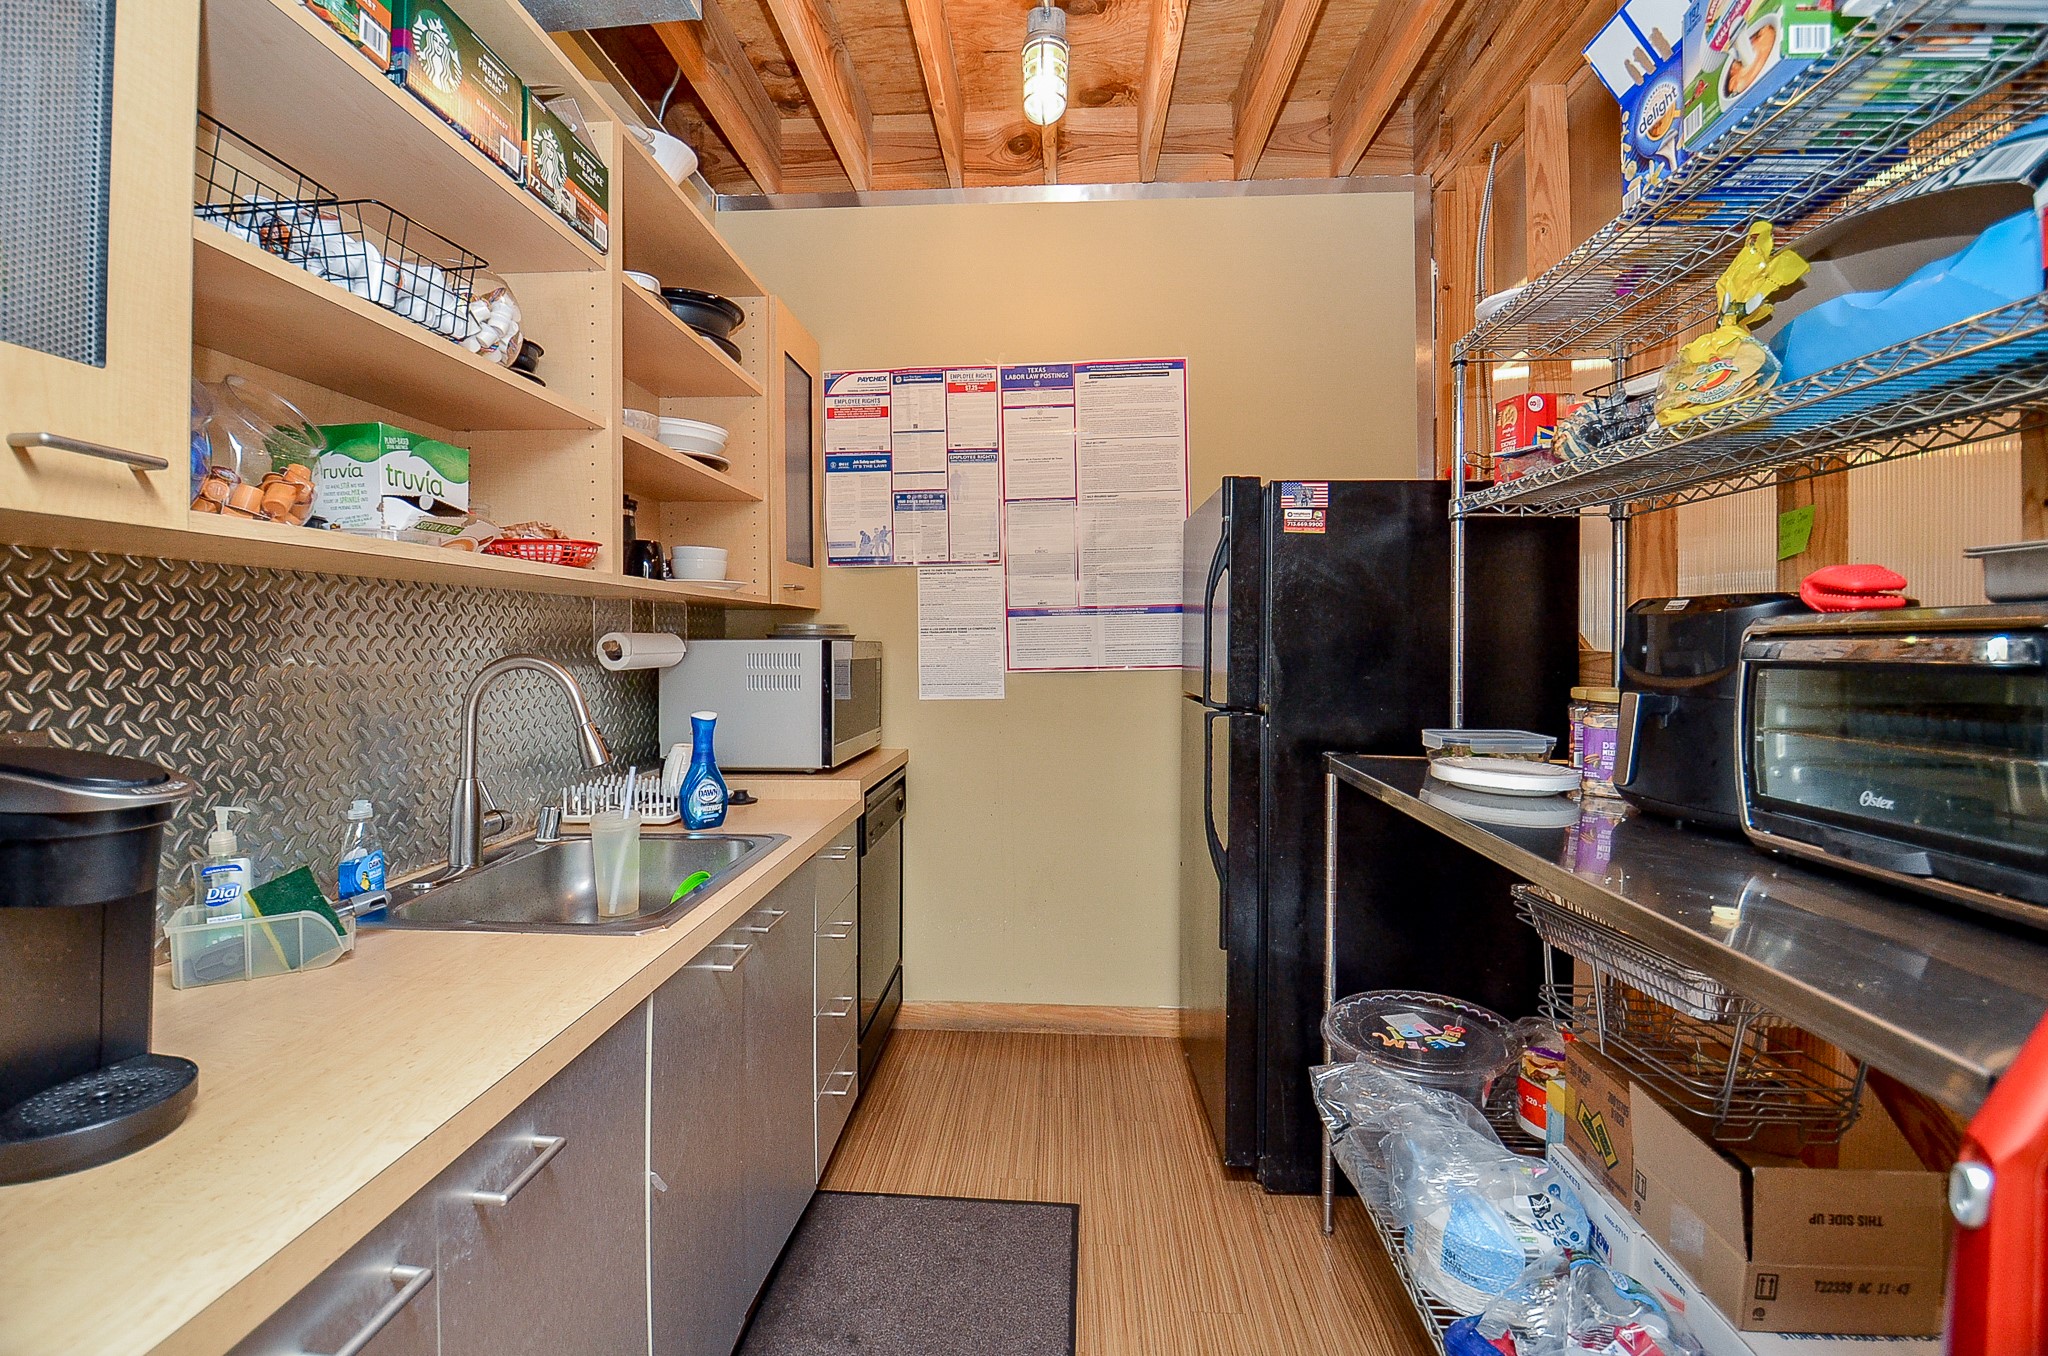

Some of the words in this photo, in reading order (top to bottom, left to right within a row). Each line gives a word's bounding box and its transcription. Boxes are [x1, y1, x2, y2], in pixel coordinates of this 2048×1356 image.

[478, 57, 509, 93] FRENCH
[484, 75, 502, 95] ROAST
[476, 98, 491, 116] DARK
[491, 111, 509, 131] ROAST
[1638, 86, 1678, 134] delight
[572, 151, 587, 171] PIKE
[586, 165, 604, 188] PLACE
[581, 170, 595, 186] ROAST
[530, 174, 541, 193] 72
[385, 463, 445, 498] truvía
[439, 524, 454, 533] LEAF
[699, 789, 718, 797] DAWN
[1859, 790, 1895, 809] Oster
[206, 885, 241, 900] Dial
[1525, 1095, 1538, 1106] 220
[1560, 1165, 1581, 1191] PACKETS
[1808, 1213, 1825, 1226] UP
[1829, 1213, 1855, 1227] SIDE
[1857, 1214, 1884, 1227] THIS
